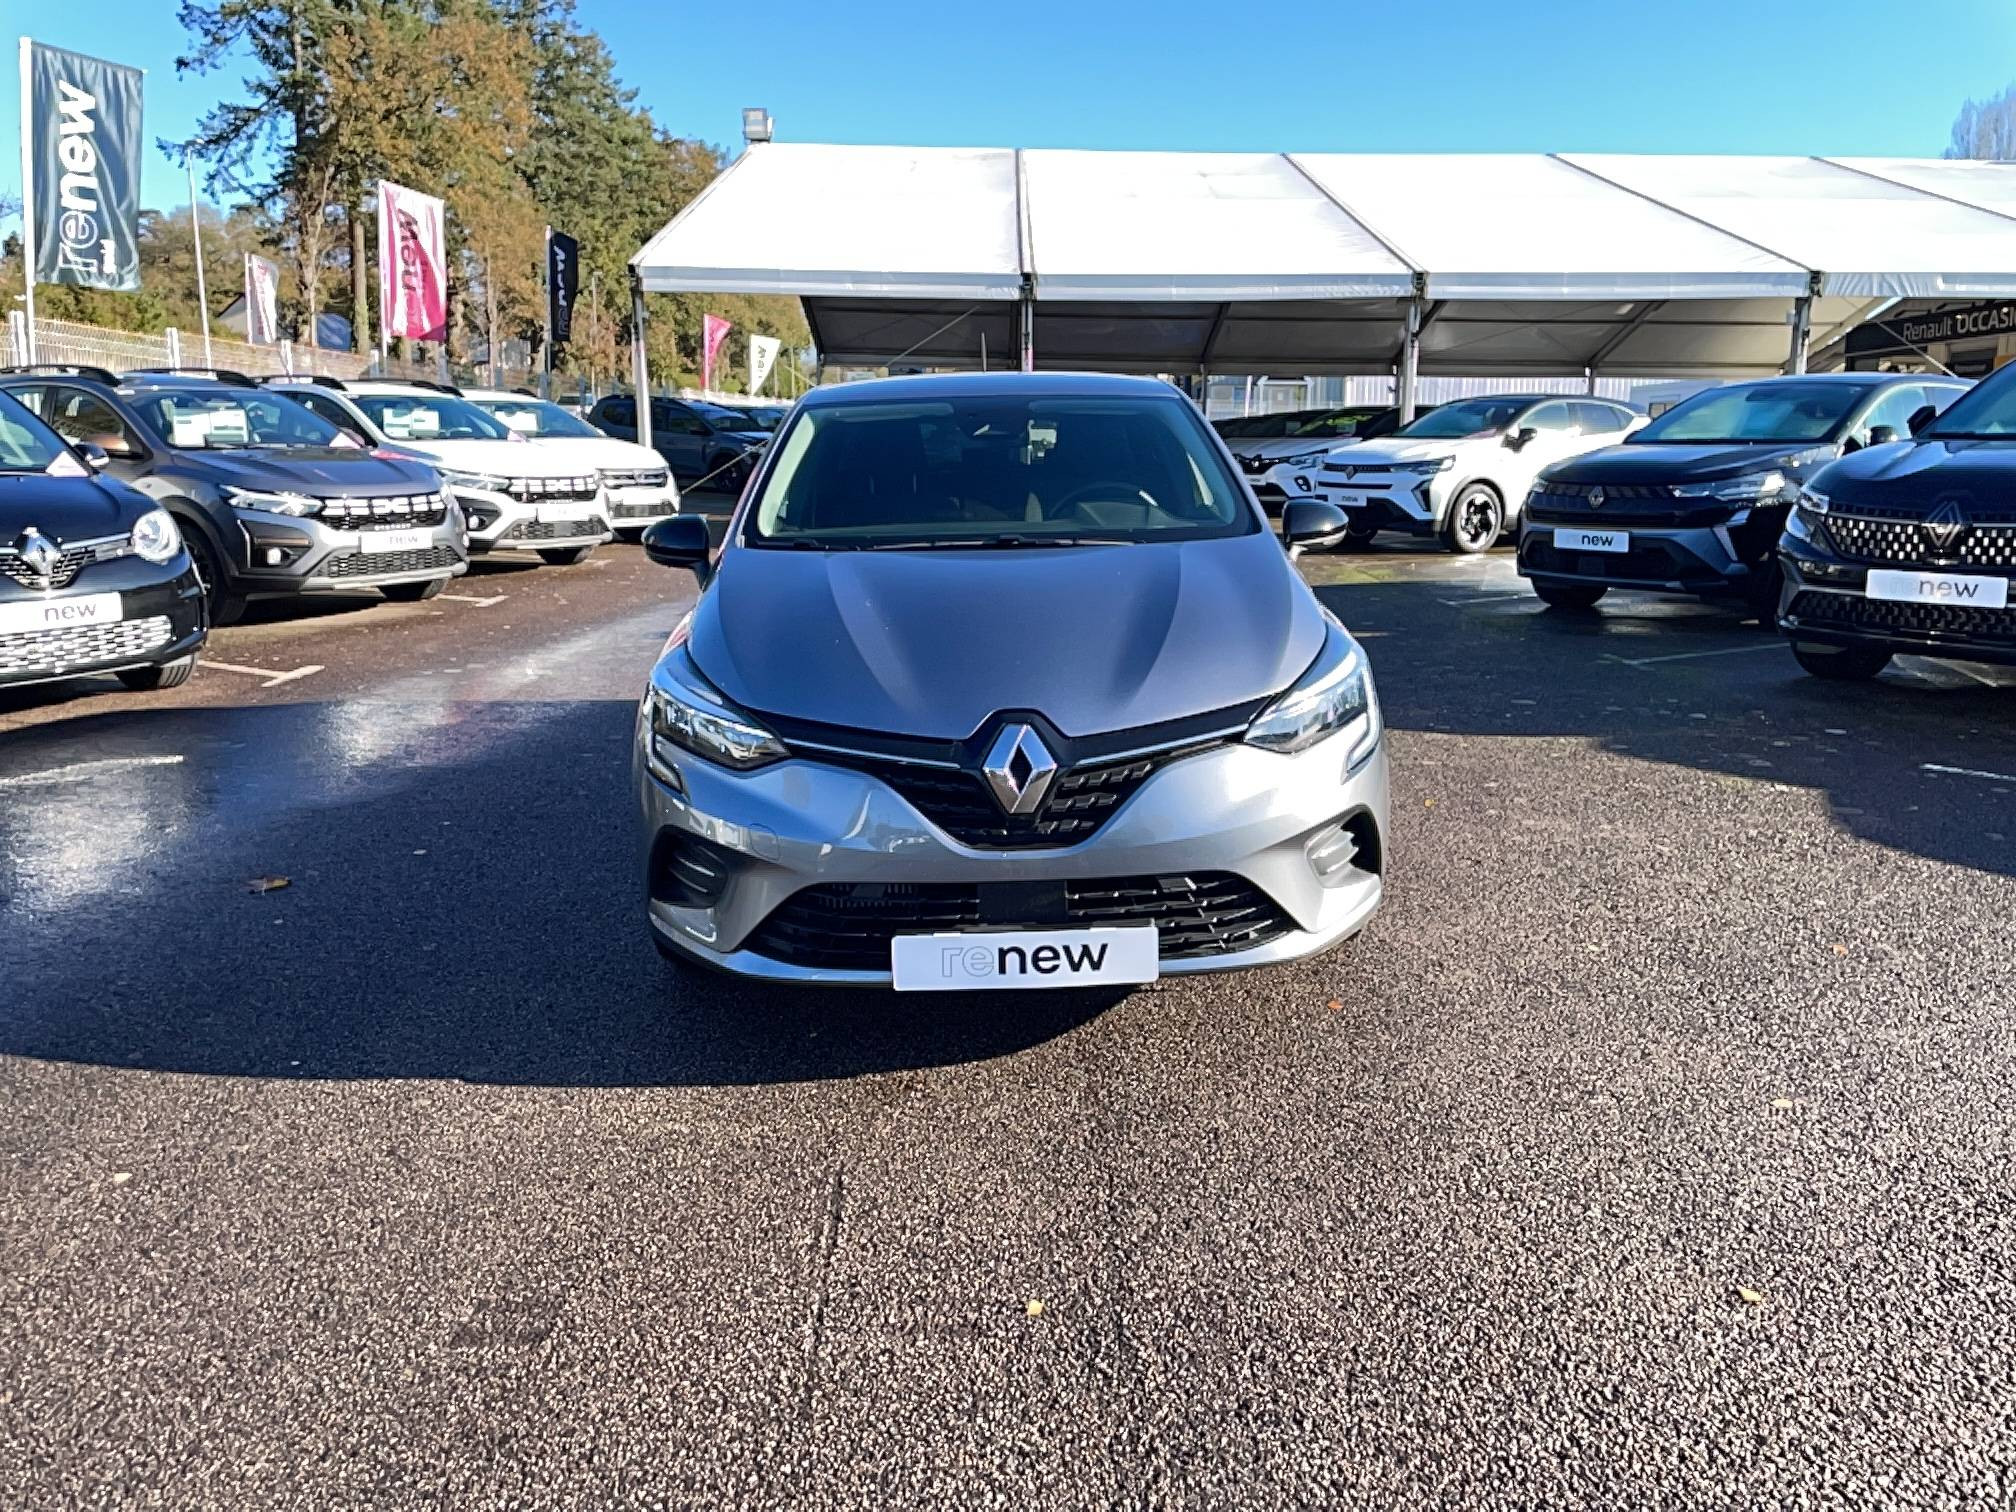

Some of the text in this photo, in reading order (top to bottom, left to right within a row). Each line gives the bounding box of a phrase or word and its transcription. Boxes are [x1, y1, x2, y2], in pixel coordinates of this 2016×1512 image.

[58, 79, 98, 273] renew
[1903, 307, 2016, 341] Renault OCCASI
[941, 942, 1109, 978] renew
